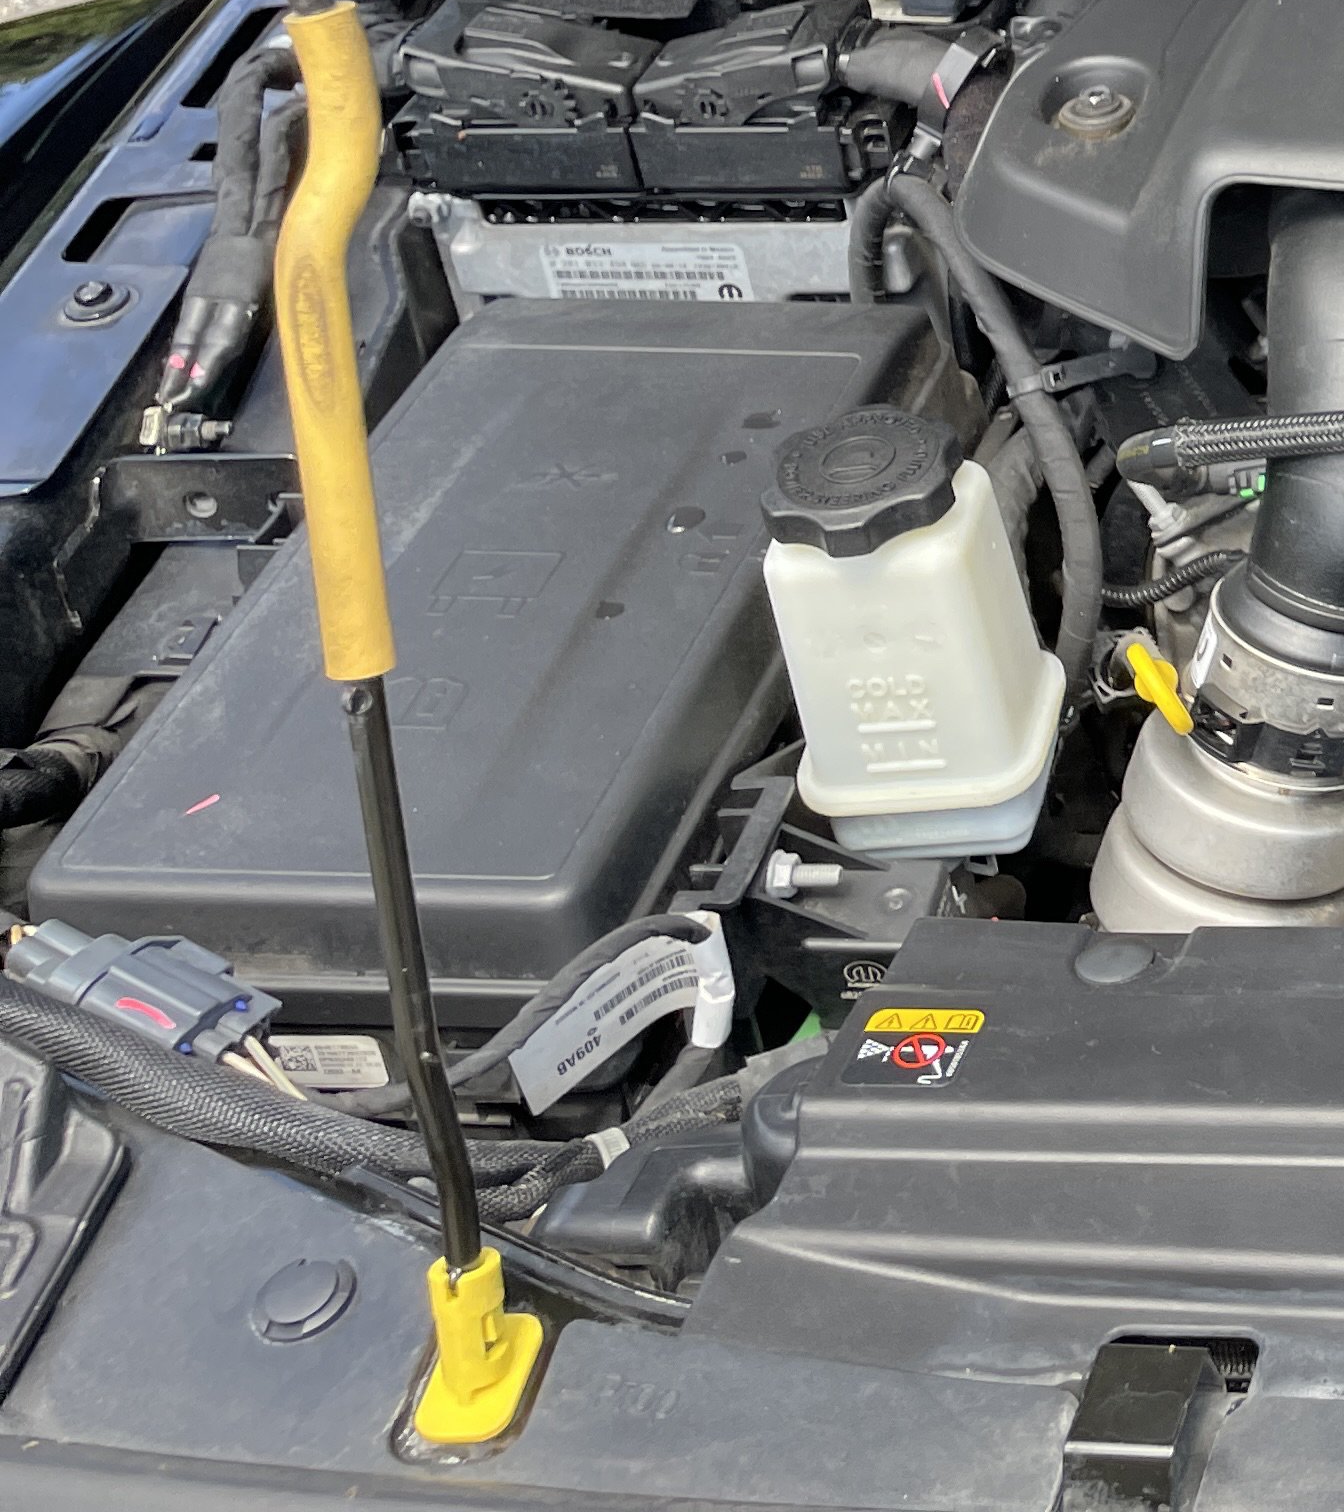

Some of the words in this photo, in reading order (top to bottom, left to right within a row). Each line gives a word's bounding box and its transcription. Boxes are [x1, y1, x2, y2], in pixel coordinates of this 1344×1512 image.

[848, 674, 926, 699] COLD
[850, 698, 933, 719] MAX
[861, 738, 939, 759] MIN
